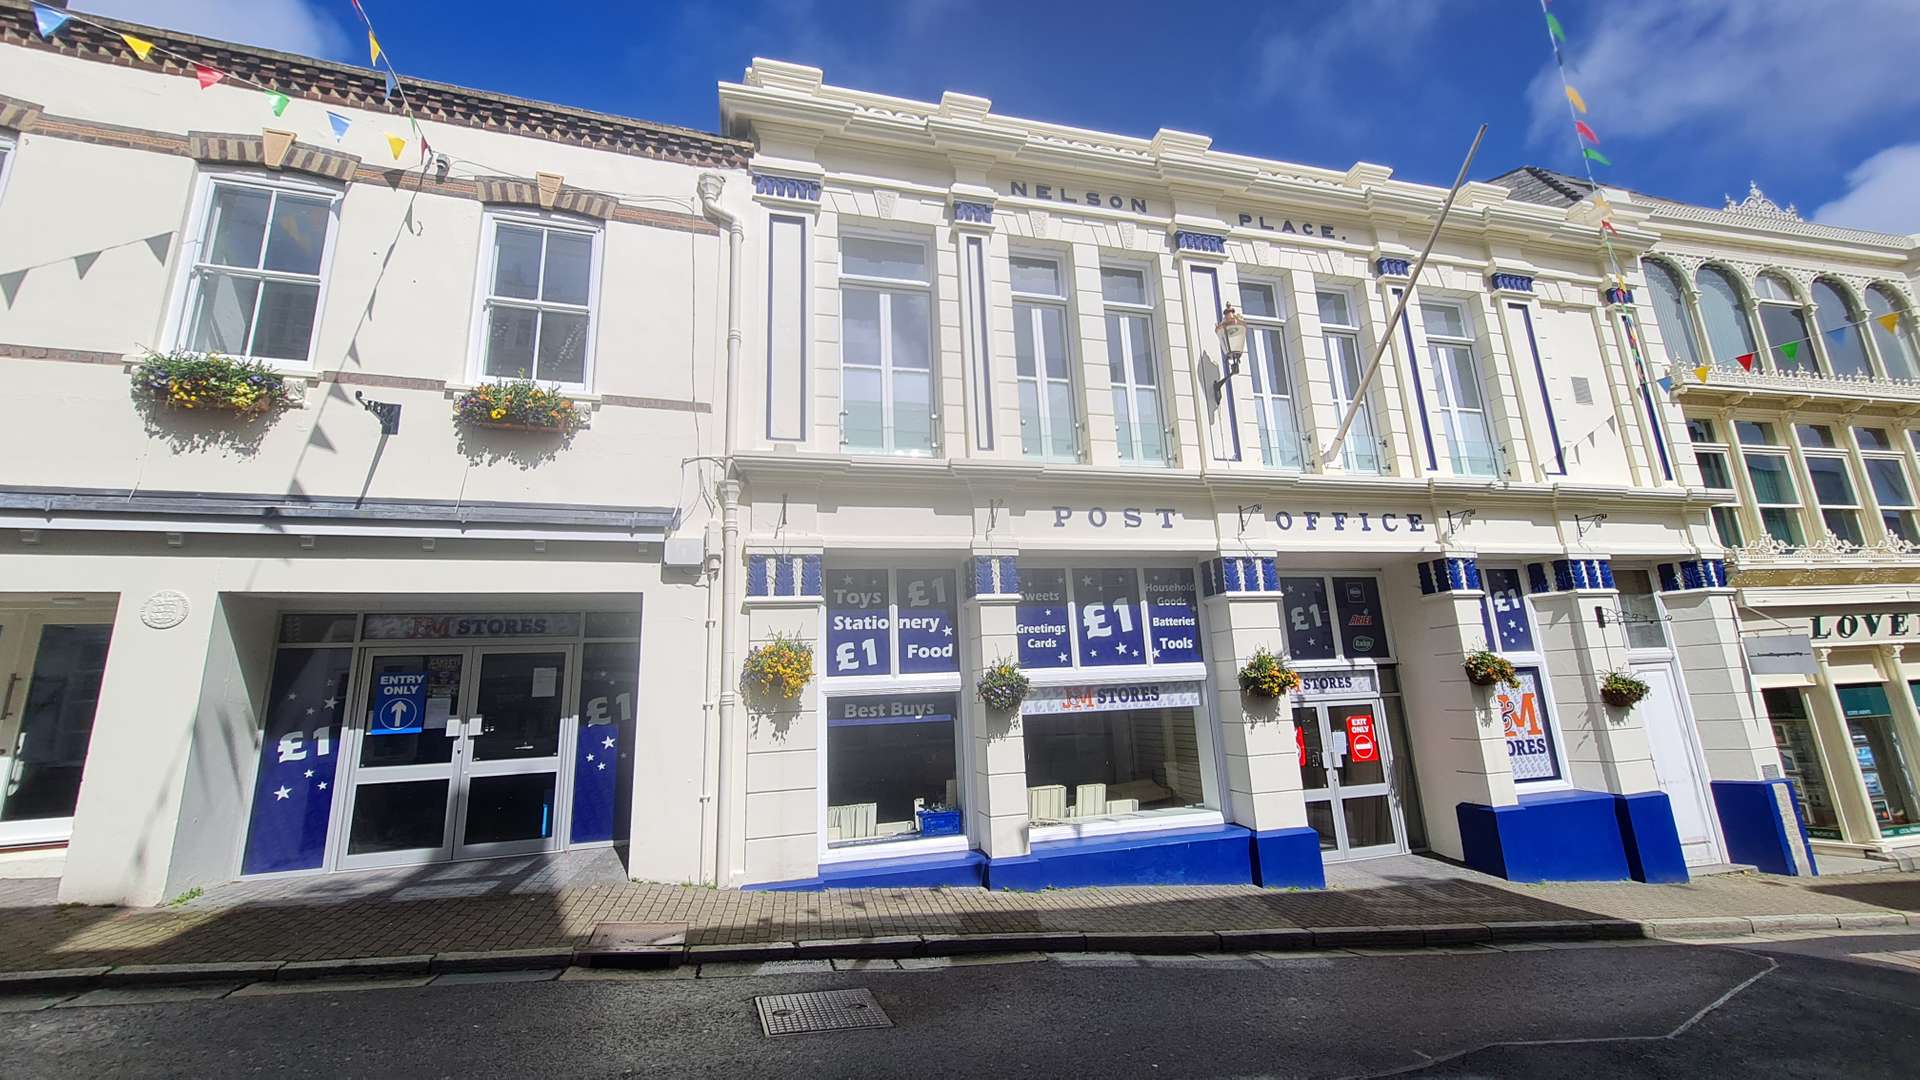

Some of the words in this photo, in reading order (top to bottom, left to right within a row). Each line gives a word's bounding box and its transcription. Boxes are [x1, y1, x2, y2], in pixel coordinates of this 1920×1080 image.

[1010, 181, 1147, 213] NELSON
[1053, 506, 1175, 528] POST
[1275, 511, 1424, 532] OFFICE
[908, 576, 946, 607] £1
[1145, 583, 1195, 592] Household
[833, 589, 882, 608] Toys
[1157, 597, 1186, 606] Goods
[1493, 589, 1520, 612] £1
[1083, 597, 1133, 640] £1
[1153, 617, 1195, 626] Batteries
[1291, 604, 1322, 631] £1
[456, 618, 547, 635] STORES
[1016, 624, 1066, 636] Greetings
[907, 643, 953, 659] Food
[1027, 638, 1057, 648] Cards
[1160, 637, 1193, 649] Tools
[836, 638, 878, 671] £1
[380, 675, 424, 685] ENTRY
[1303, 677, 1352, 690] STORES
[383, 686, 420, 695] ONLY
[1097, 686, 1160, 704] STORES
[587, 693, 632, 727] £1
[844, 703, 886, 718] Best
[891, 702, 935, 719] Buys
[1351, 718, 1367, 726] EXIT
[276, 726, 330, 763] £1
